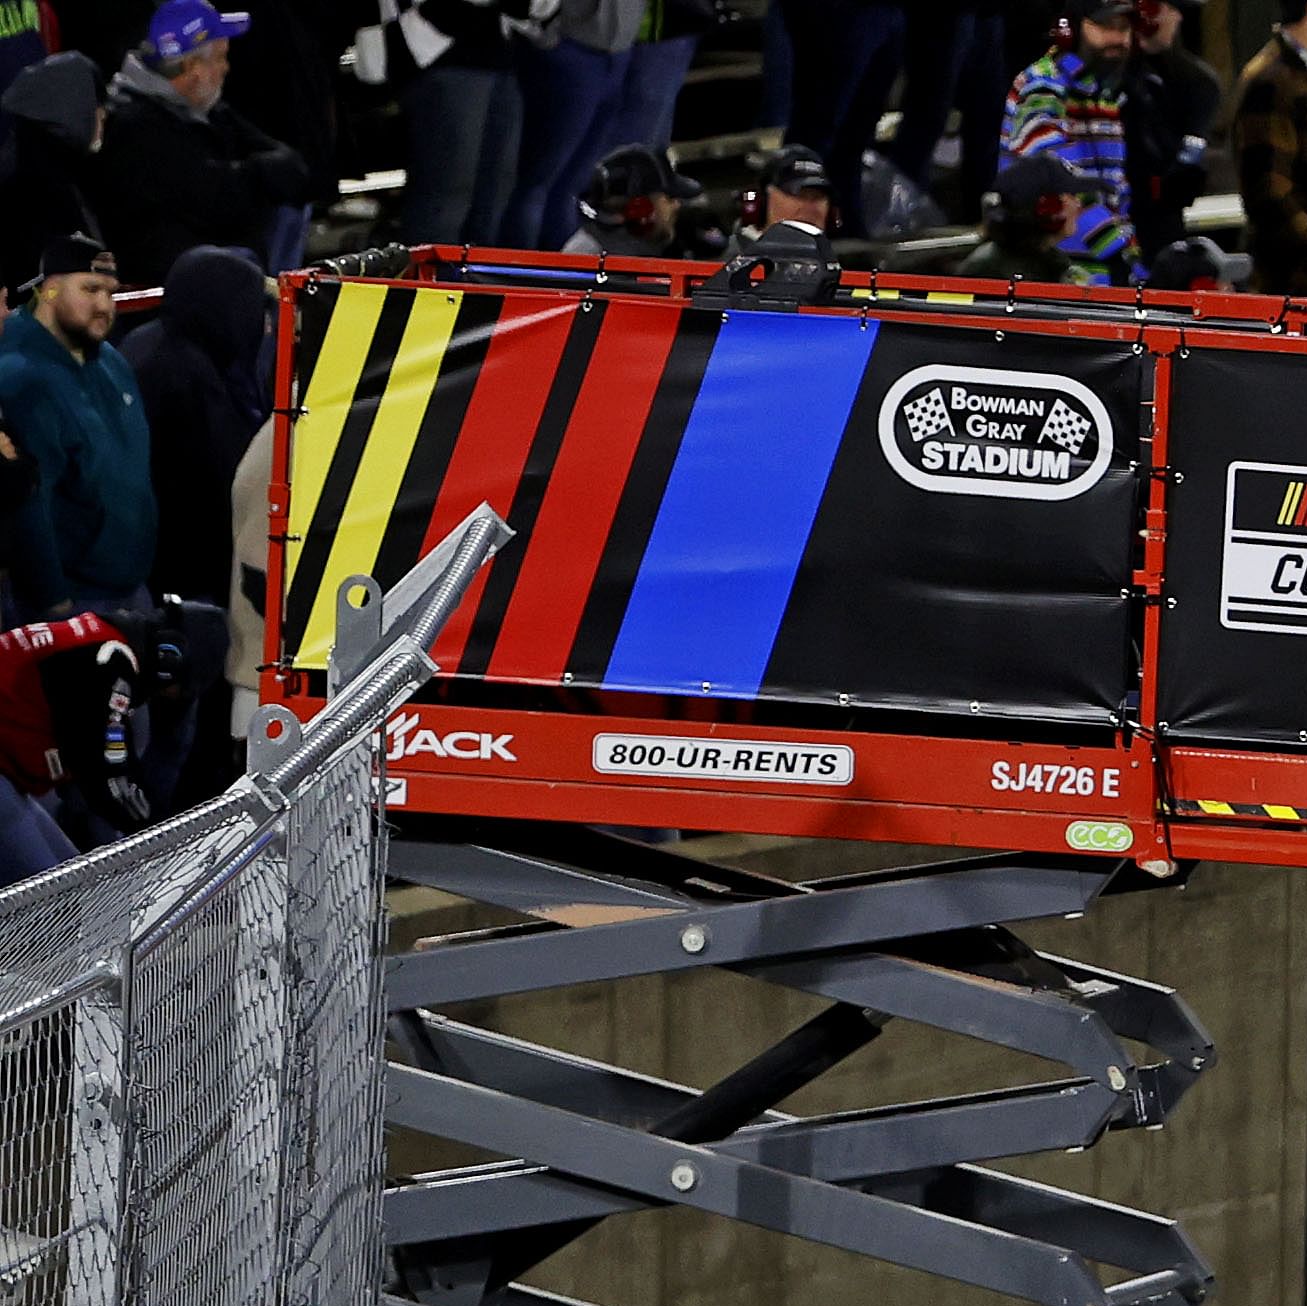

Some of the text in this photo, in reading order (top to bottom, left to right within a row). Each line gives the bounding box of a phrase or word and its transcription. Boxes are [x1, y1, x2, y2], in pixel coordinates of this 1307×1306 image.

[951, 386, 1045, 417] BOWMAN
[965, 414, 1027, 441] GRAY
[921, 441, 1071, 479] STADIUM
[385, 712, 517, 762] JACK
[608, 743, 839, 777] 800-UR-RENTS
[991, 760, 1121, 798] SJ4726 E
[1070, 824, 1129, 849] eco
